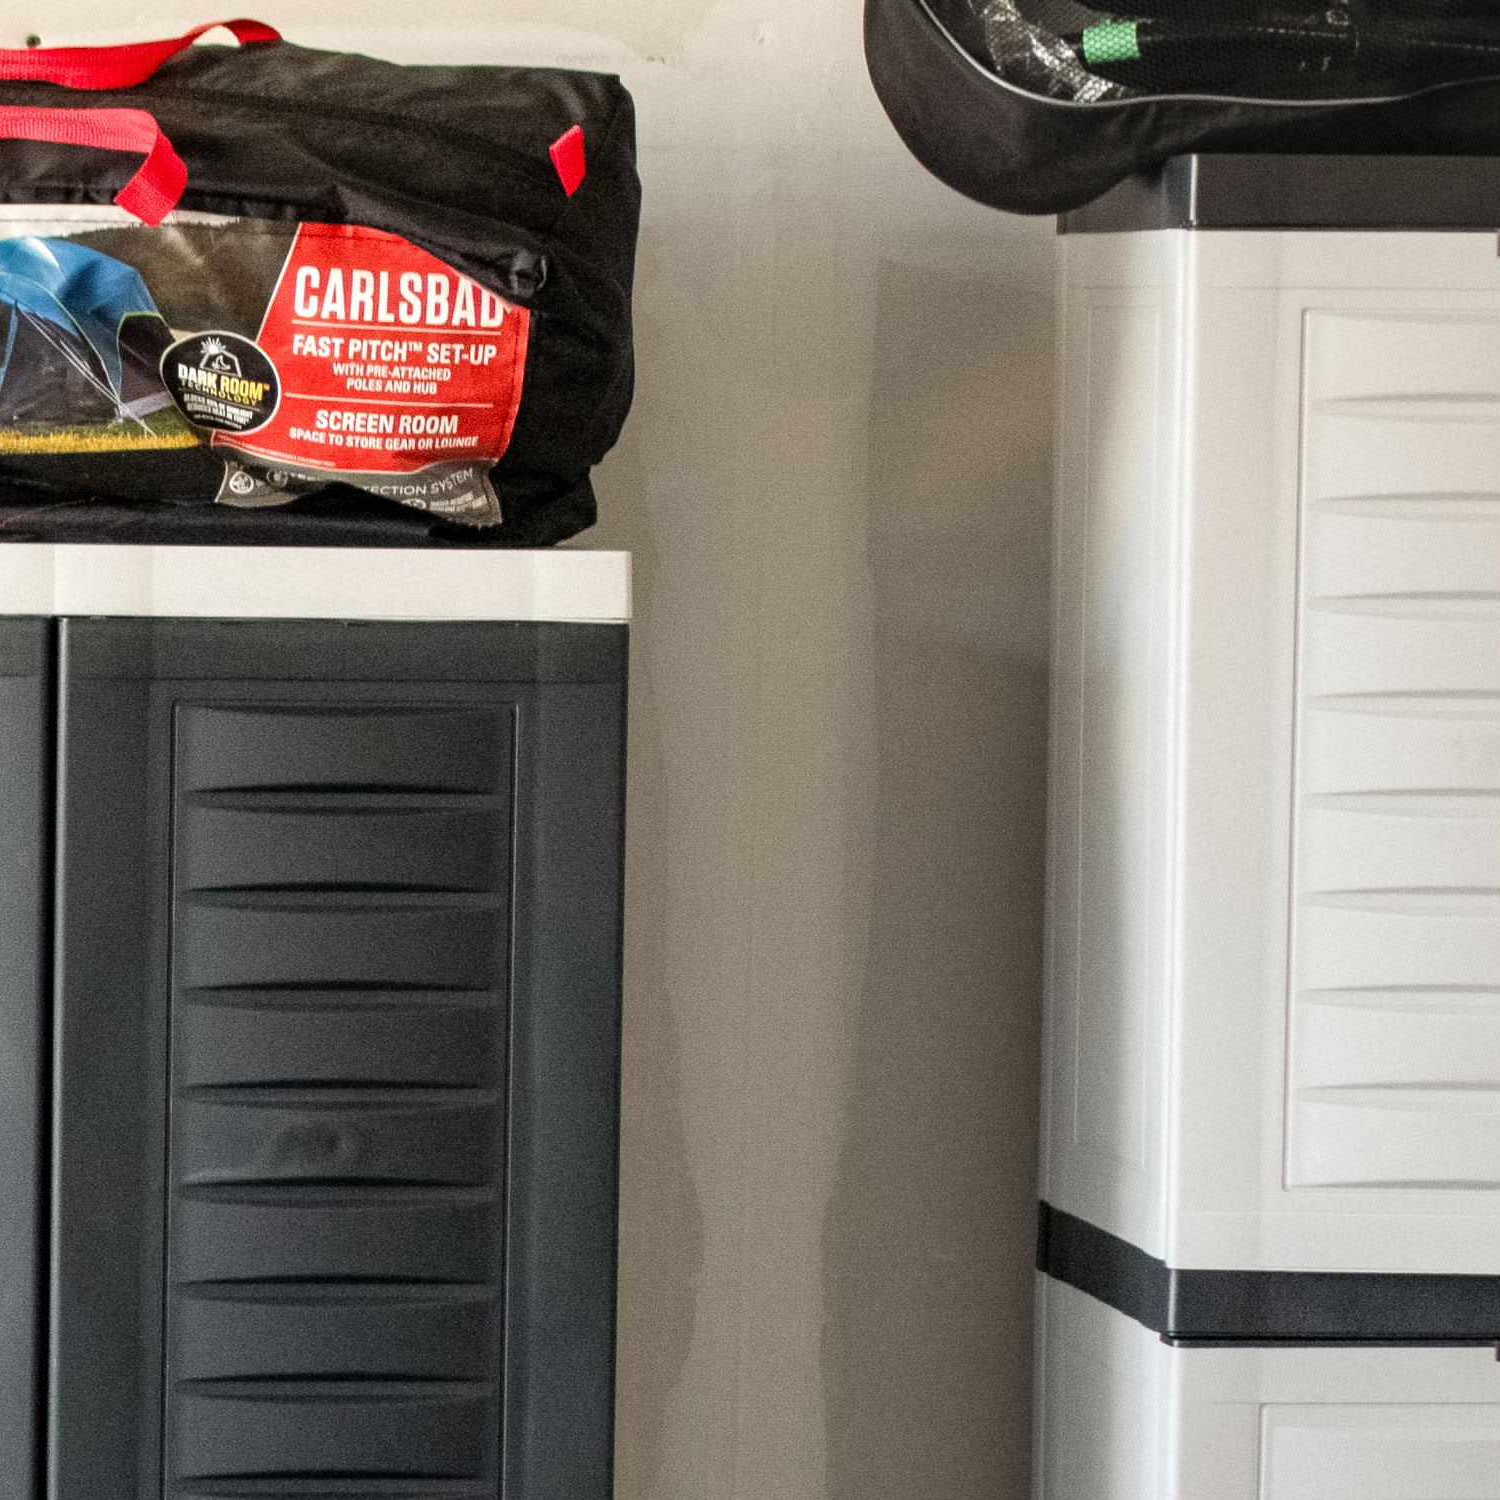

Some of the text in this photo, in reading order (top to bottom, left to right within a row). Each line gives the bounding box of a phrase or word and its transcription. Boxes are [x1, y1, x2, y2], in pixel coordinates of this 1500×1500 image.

[294, 265, 504, 328] CARLSBAD
[293, 334, 344, 358] FAST
[427, 343, 497, 365] SET-UP
[178, 363, 217, 388] DARK
[333, 363, 451, 381] WITH PRE-ATTACHED
[347, 377, 437, 394] POLES AND HUB
[316, 410, 458, 434] SCREEN ROOM
[290, 427, 478, 450] SPACE TO STORE GEAR OR LOUNGE
[430, 468, 473, 493] SYSTEM
